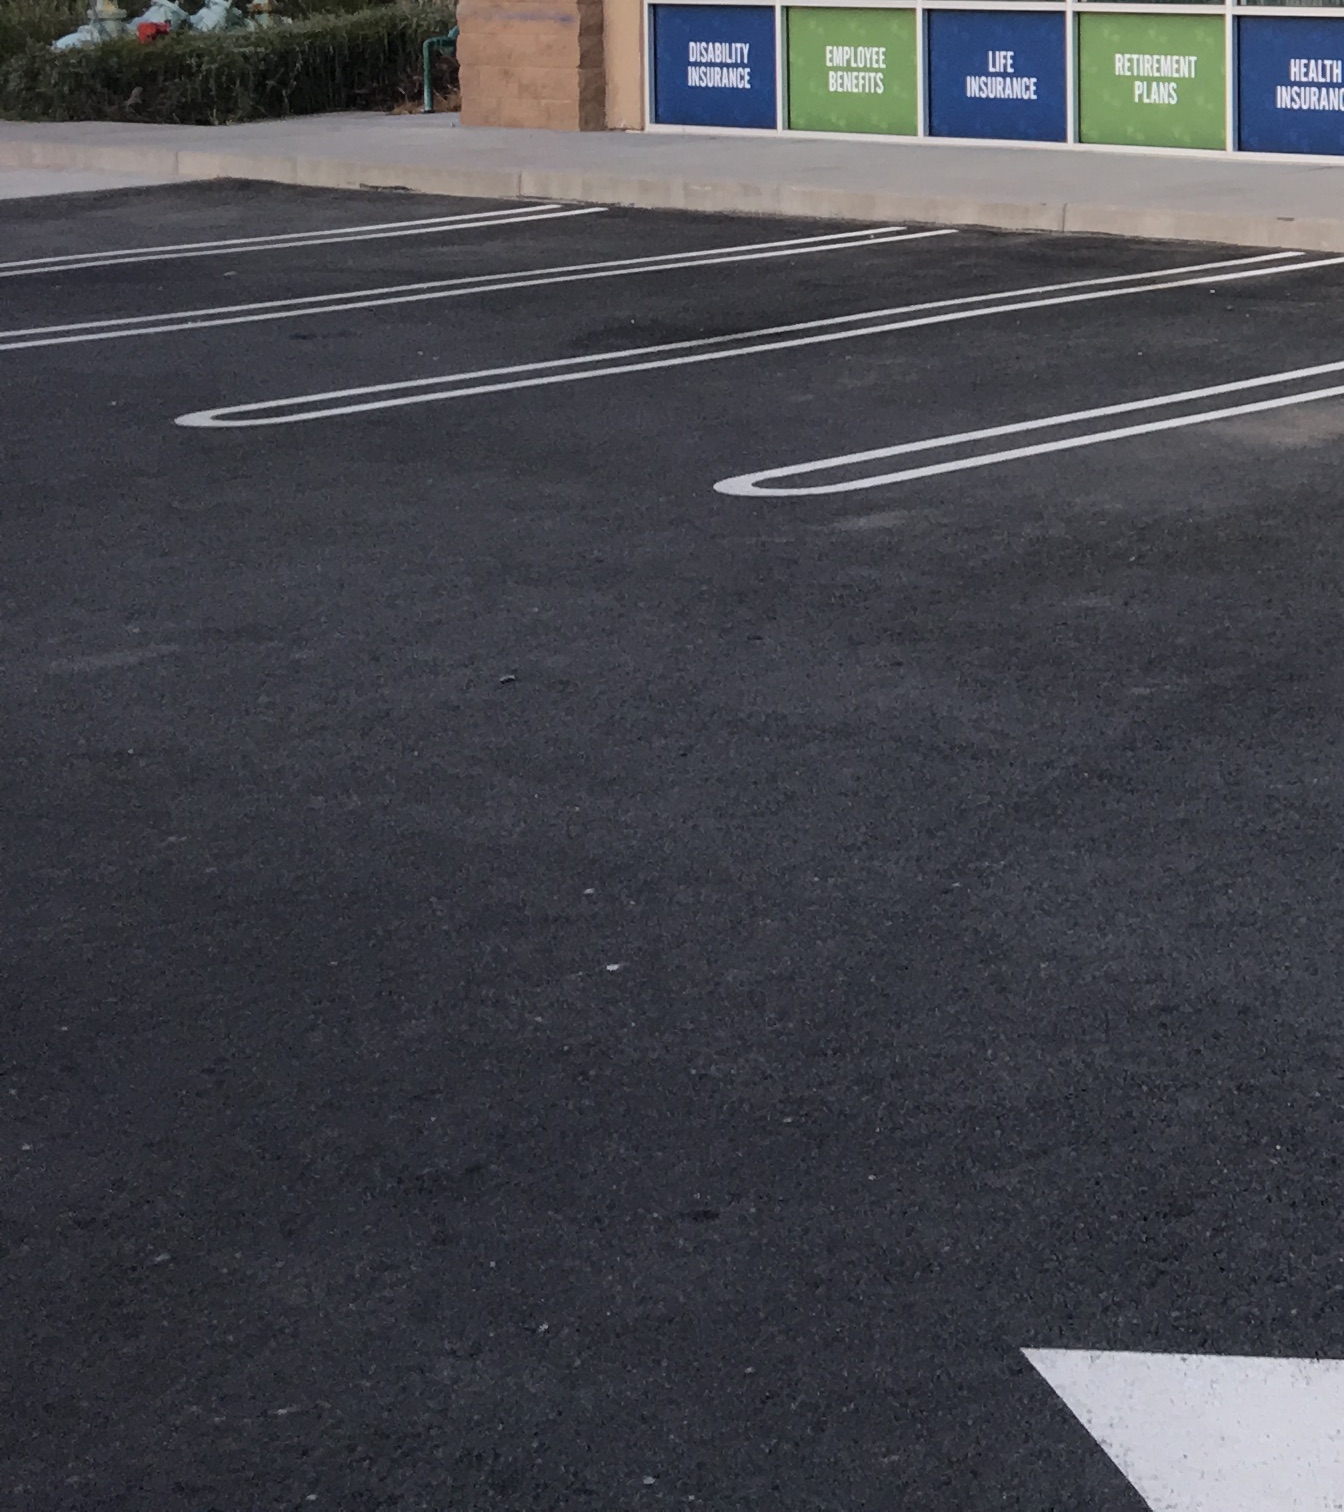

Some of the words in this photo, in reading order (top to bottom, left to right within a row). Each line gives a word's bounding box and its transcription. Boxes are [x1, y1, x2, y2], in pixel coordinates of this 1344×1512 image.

[688, 41, 750, 65] DISABILITY
[825, 45, 887, 69] EMPLOYEE
[988, 50, 1015, 73] LIFE
[687, 65, 751, 89] INSURANCE
[1114, 53, 1198, 79] RETIREMENT
[1290, 58, 1342, 83] HEALTH
[828, 70, 885, 94] BENEFITS
[966, 76, 1038, 100] INSURANCE
[1134, 81, 1178, 105] PLANS
